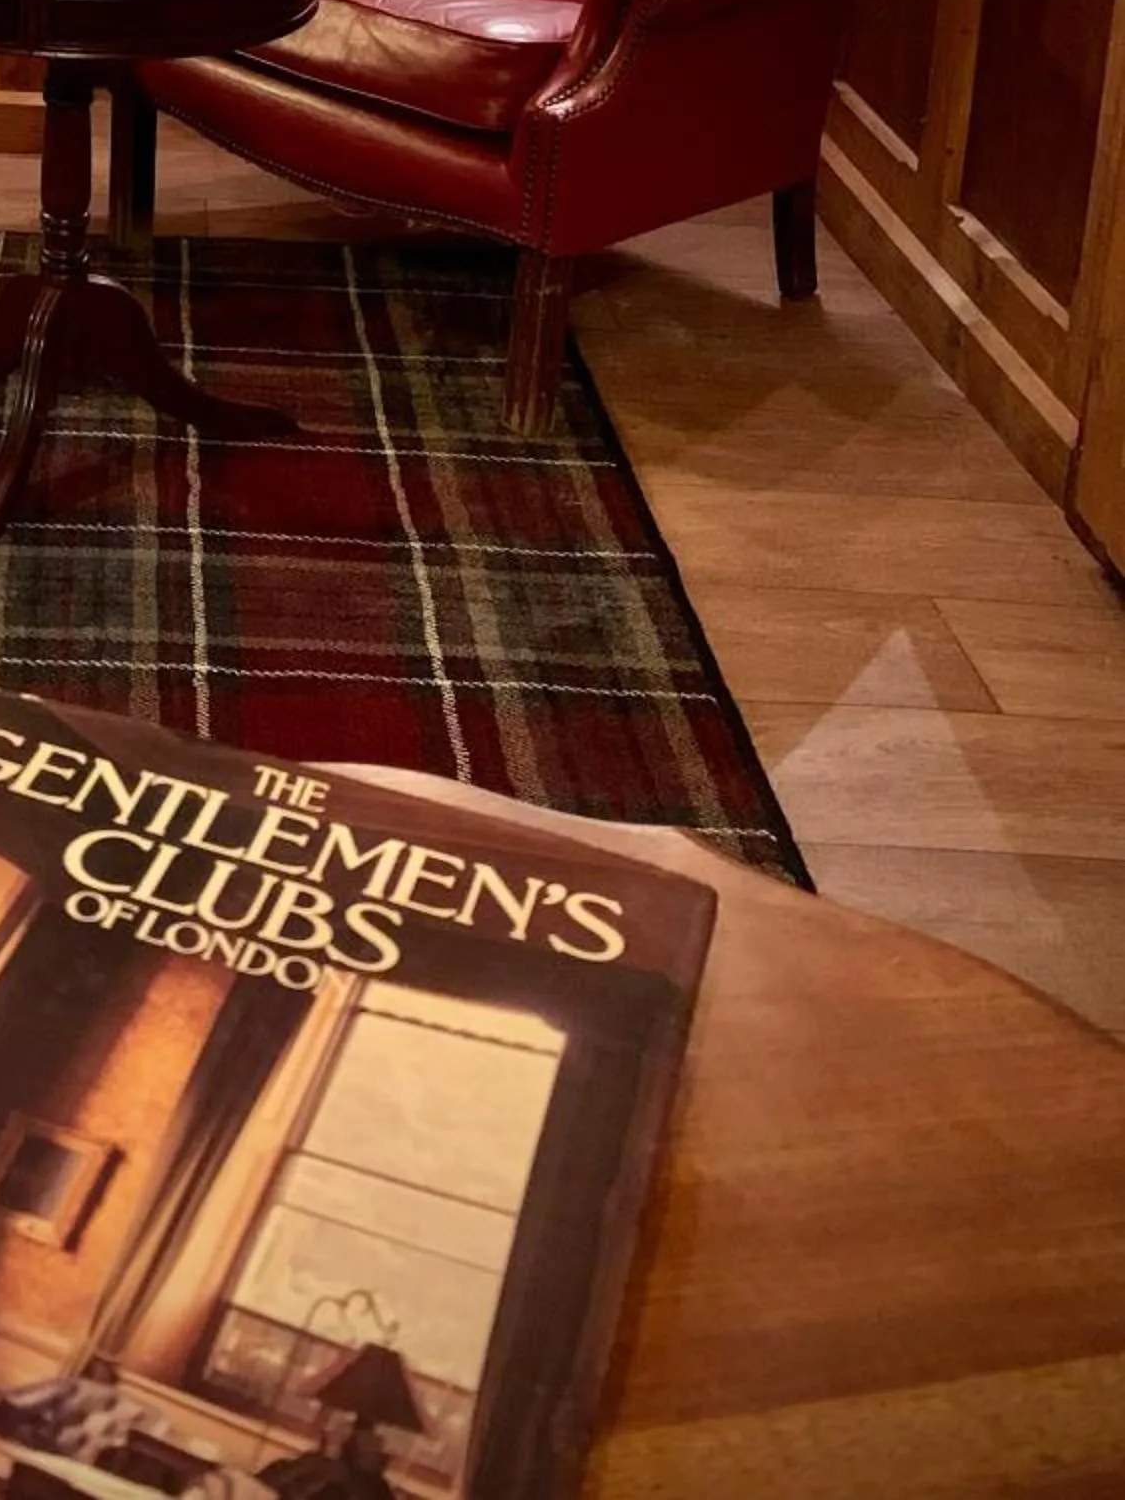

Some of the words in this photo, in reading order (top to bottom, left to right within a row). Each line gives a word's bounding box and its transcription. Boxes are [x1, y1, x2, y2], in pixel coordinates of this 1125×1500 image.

[253, 764, 332, 814] THE
[63, 829, 402, 973] CLUBS
[66, 892, 138, 930] OF
